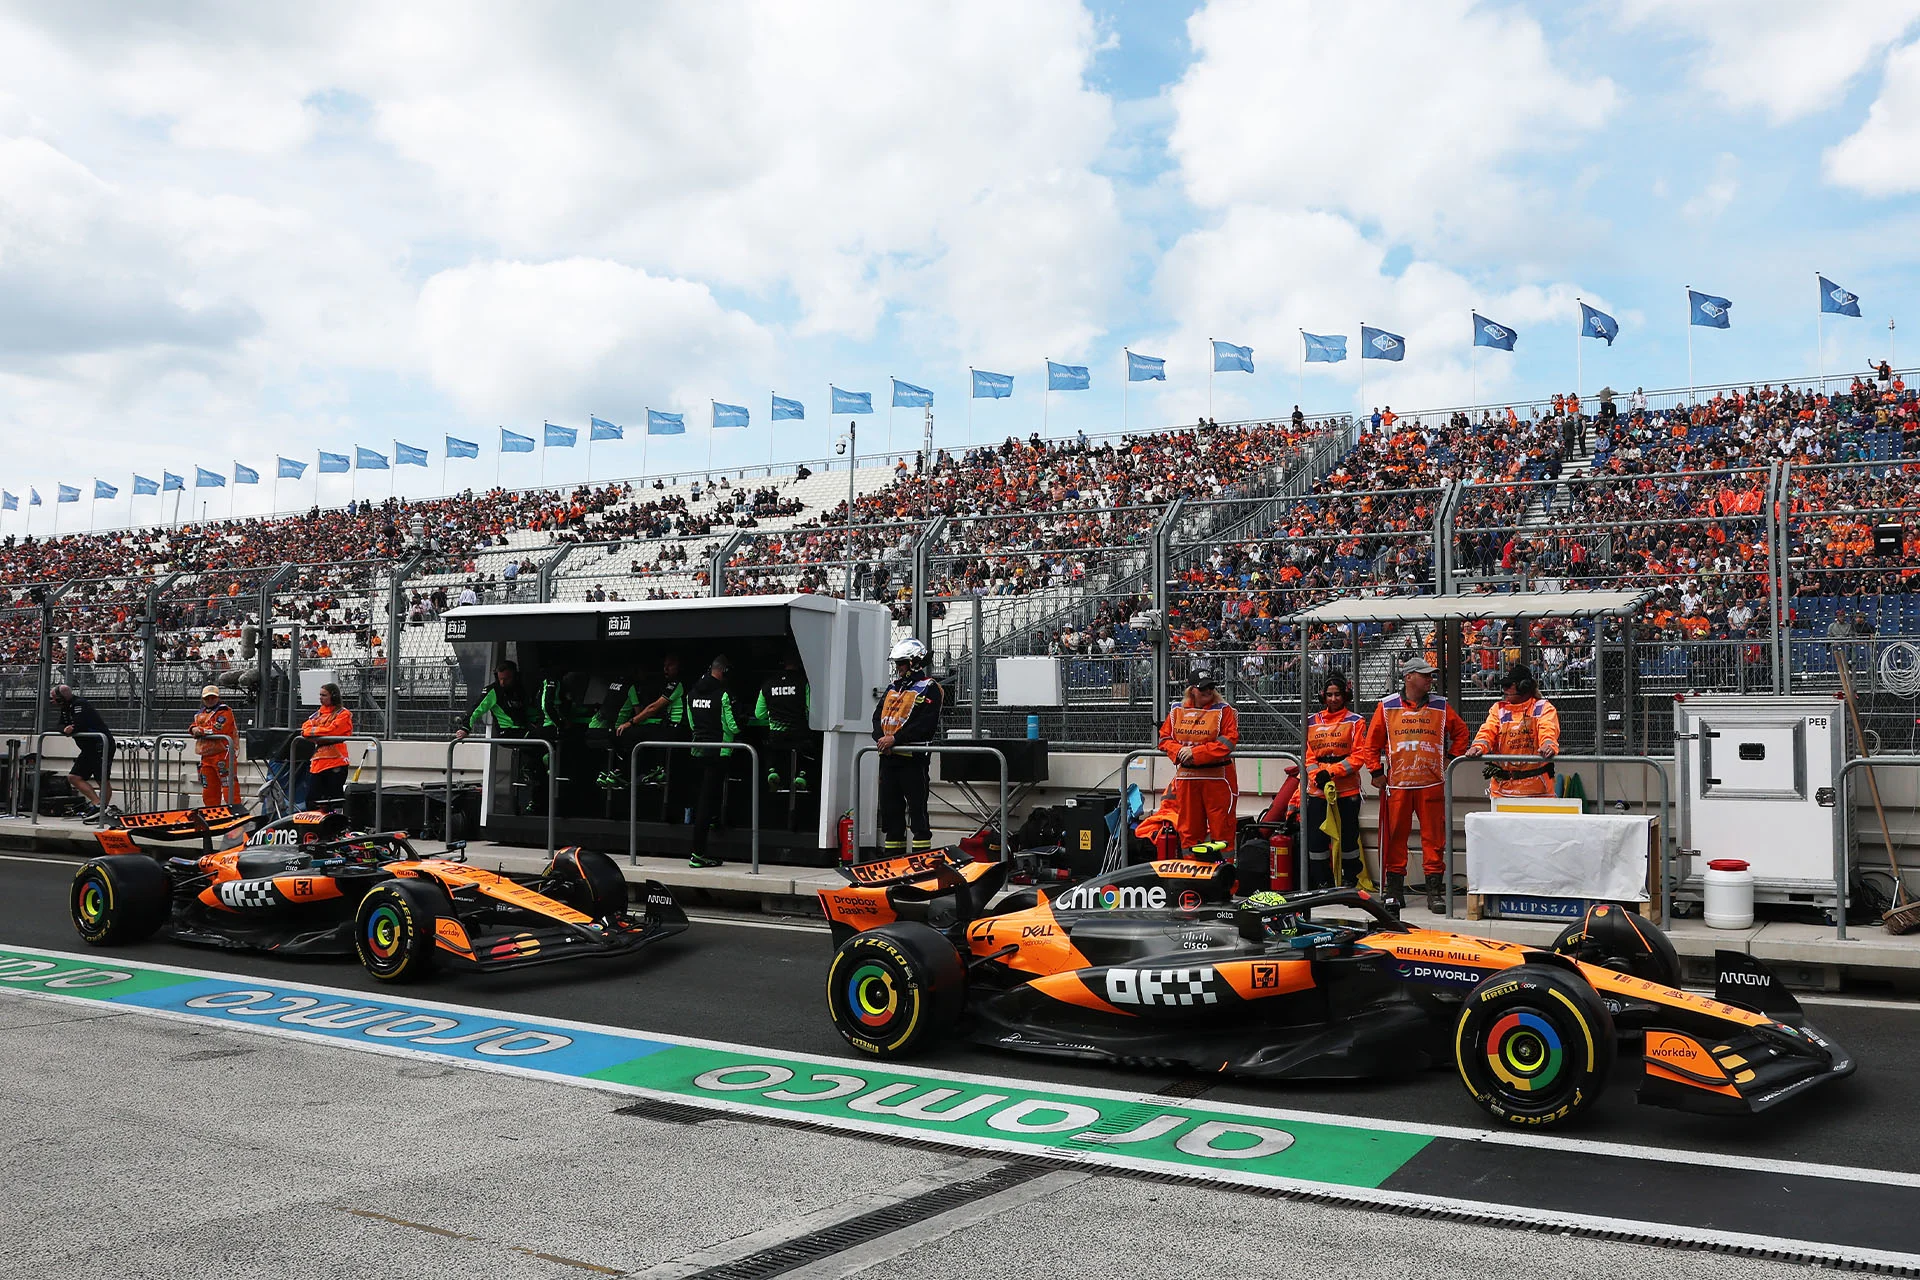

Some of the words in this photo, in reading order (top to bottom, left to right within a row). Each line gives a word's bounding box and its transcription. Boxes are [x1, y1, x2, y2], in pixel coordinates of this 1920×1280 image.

[771, 685, 796, 697] KICK
[692, 698, 712, 709] KICK
[1808, 717, 1828, 727] PEB
[853, 862, 897, 882] OKX
[1158, 862, 1213, 878] allwyn
[221, 881, 276, 908] OKX
[834, 895, 877, 907] Dropbox
[837, 906, 865, 915] Dash
[1216, 911, 1234, 919] okta
[971, 919, 997, 945] 4
[1021, 924, 1054, 938] DELL
[854, 938, 864, 948] P
[866, 938, 908, 967] ZERO
[1396, 946, 1444, 959] RICHARD
[1447, 951, 1481, 962] MILLE
[1414, 967, 1432, 977] DP
[1433, 968, 1480, 983] WORLD
[1719, 971, 1771, 987] ARROW
[1106, 967, 1219, 1006] OKX
[1480, 980, 1519, 1003] PIRELLI
[184, 990, 574, 1057] aramco
[1651, 1046, 1698, 1061] workday
[693, 1063, 1296, 1160] aramco
[1509, 1104, 1569, 1125] ZERO
